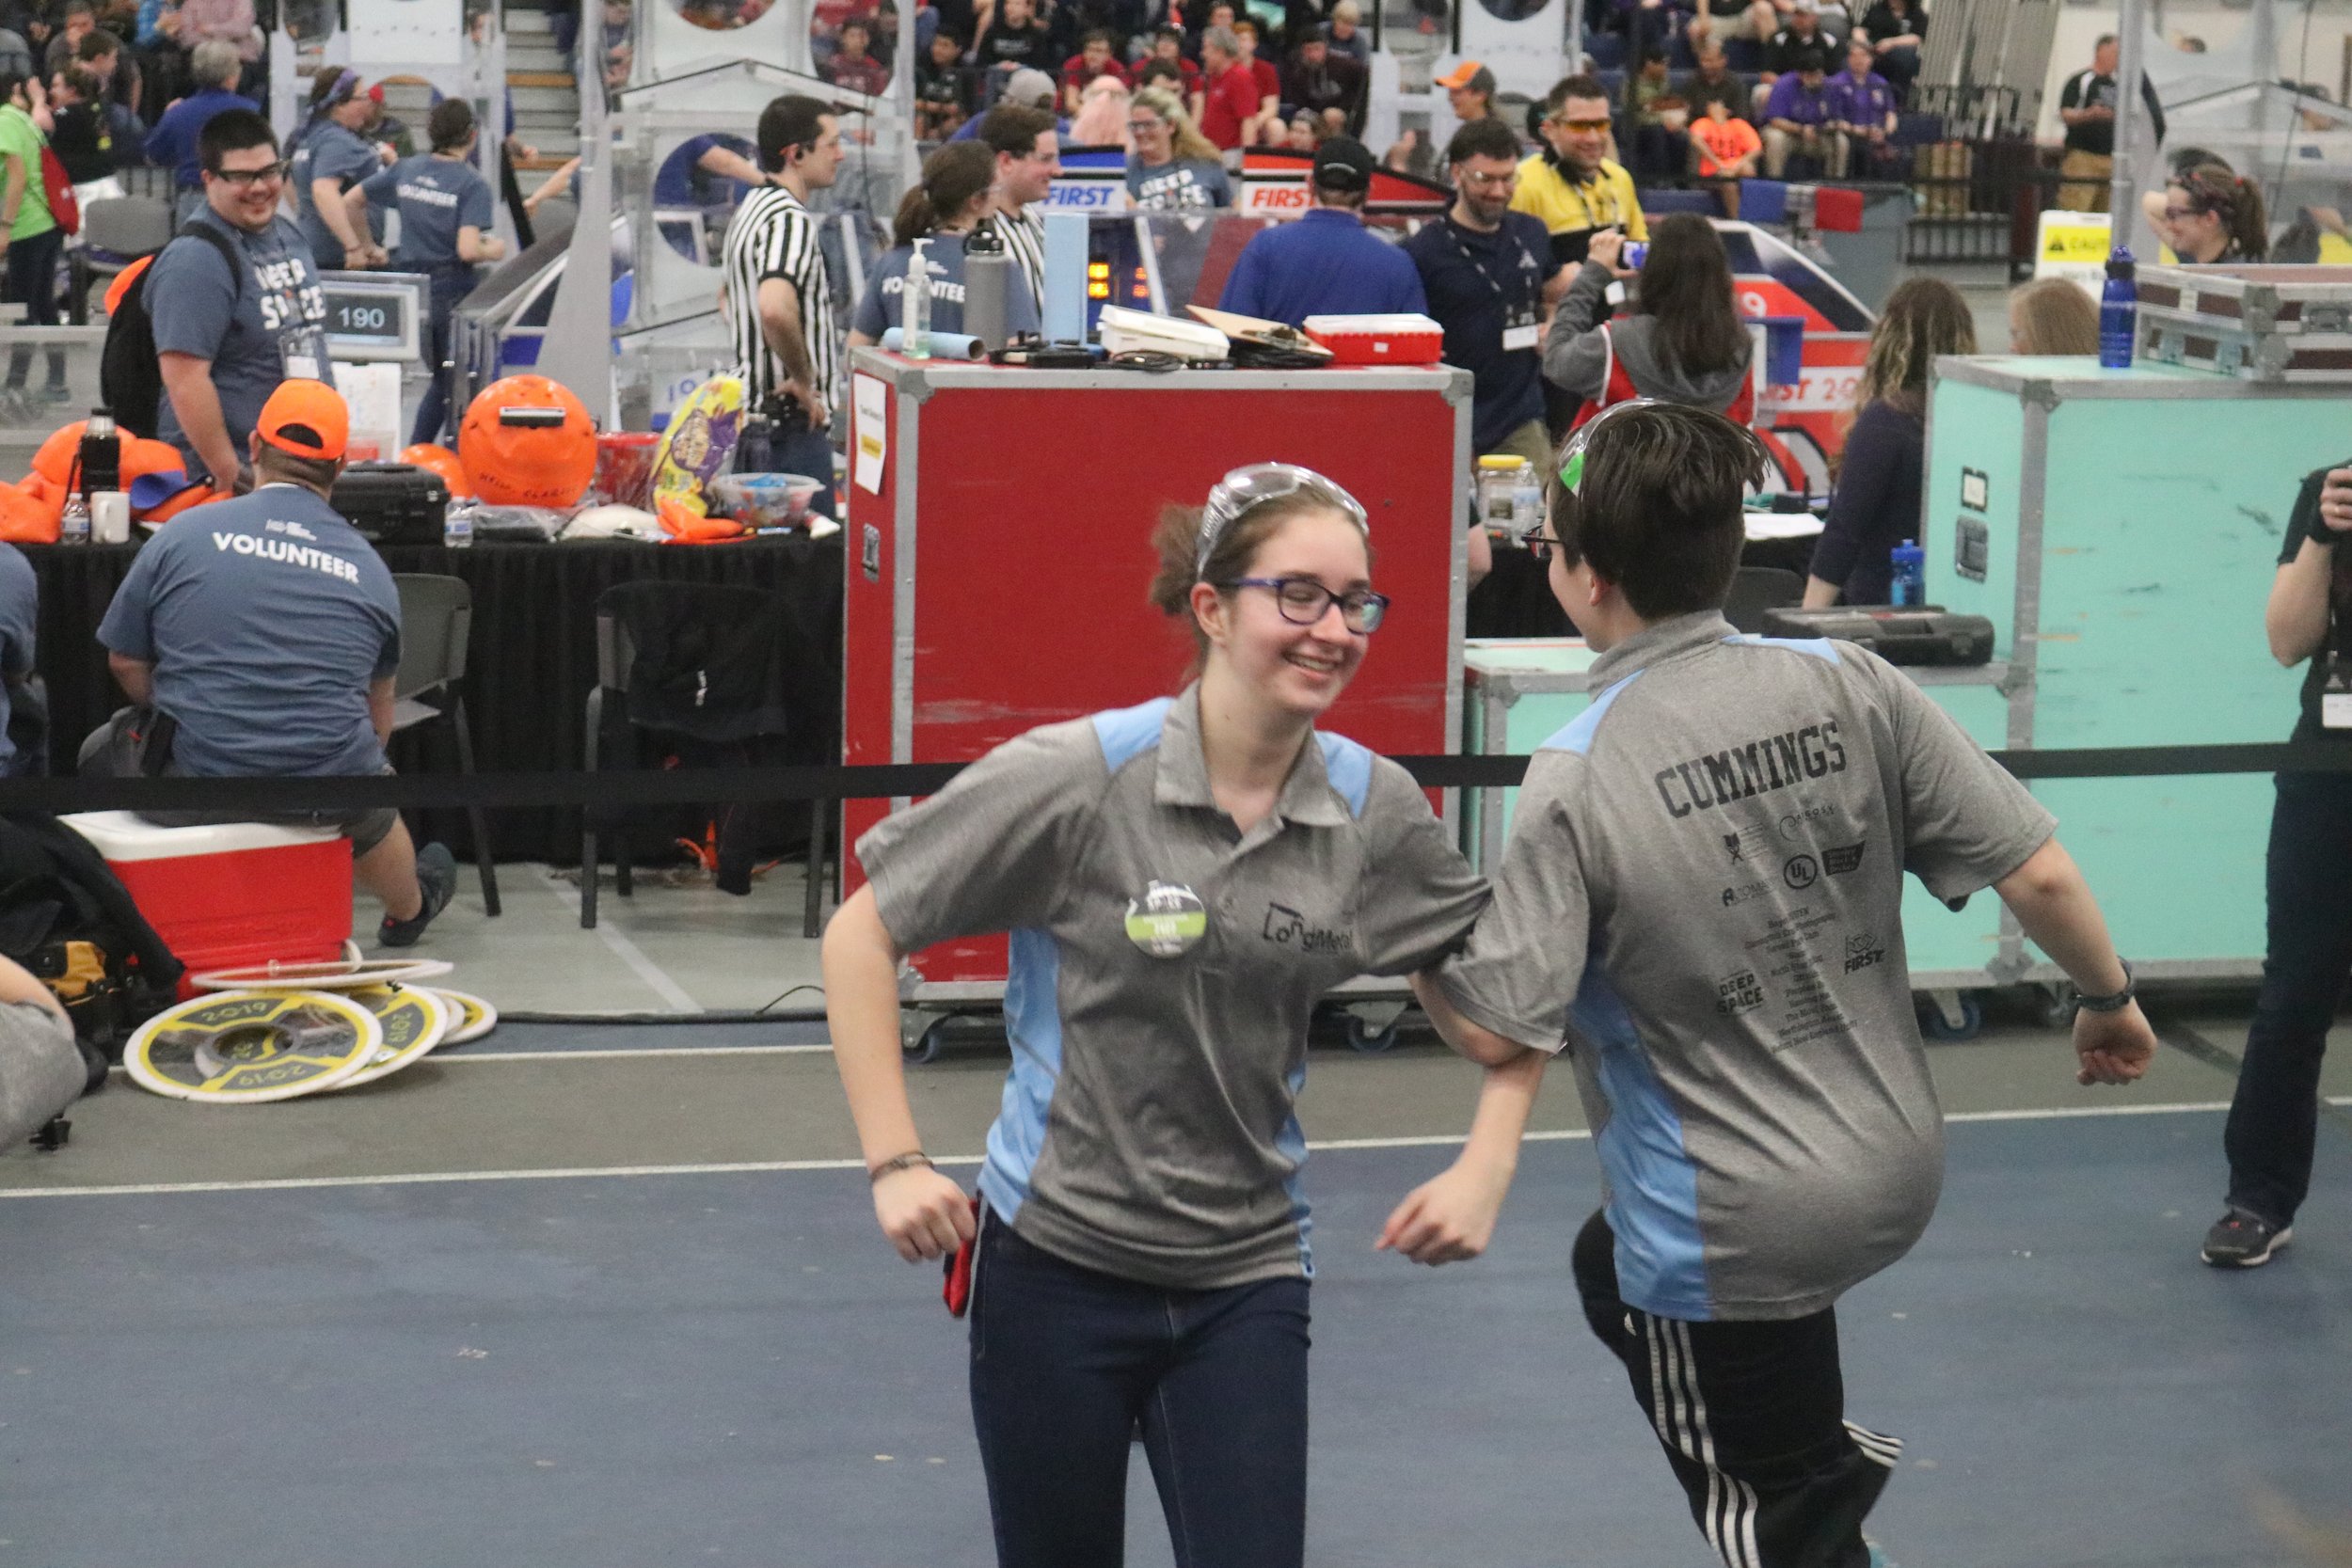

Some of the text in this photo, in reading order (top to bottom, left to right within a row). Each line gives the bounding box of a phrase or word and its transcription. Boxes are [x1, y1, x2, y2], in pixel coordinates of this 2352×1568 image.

[1043, 185, 1115, 206] FIRST
[1136, 184, 1206, 210] SPCE
[2069, 237, 2110, 252] CAUT
[882, 276, 966, 304] VONTEE
[260, 285, 326, 330] SPCE
[339, 307, 386, 329] 190
[212, 531, 359, 584] VOLUNTEER
[1654, 721, 1847, 818] CUMMINGS
[1790, 863, 1811, 881] UL
[1844, 949, 1885, 975] FIRST
[1719, 974, 1755, 996] DEEP
[201, 1002, 266, 1022] 2019
[1716, 987, 1764, 1014] SPACE
[239, 1065, 306, 1086] 2019
